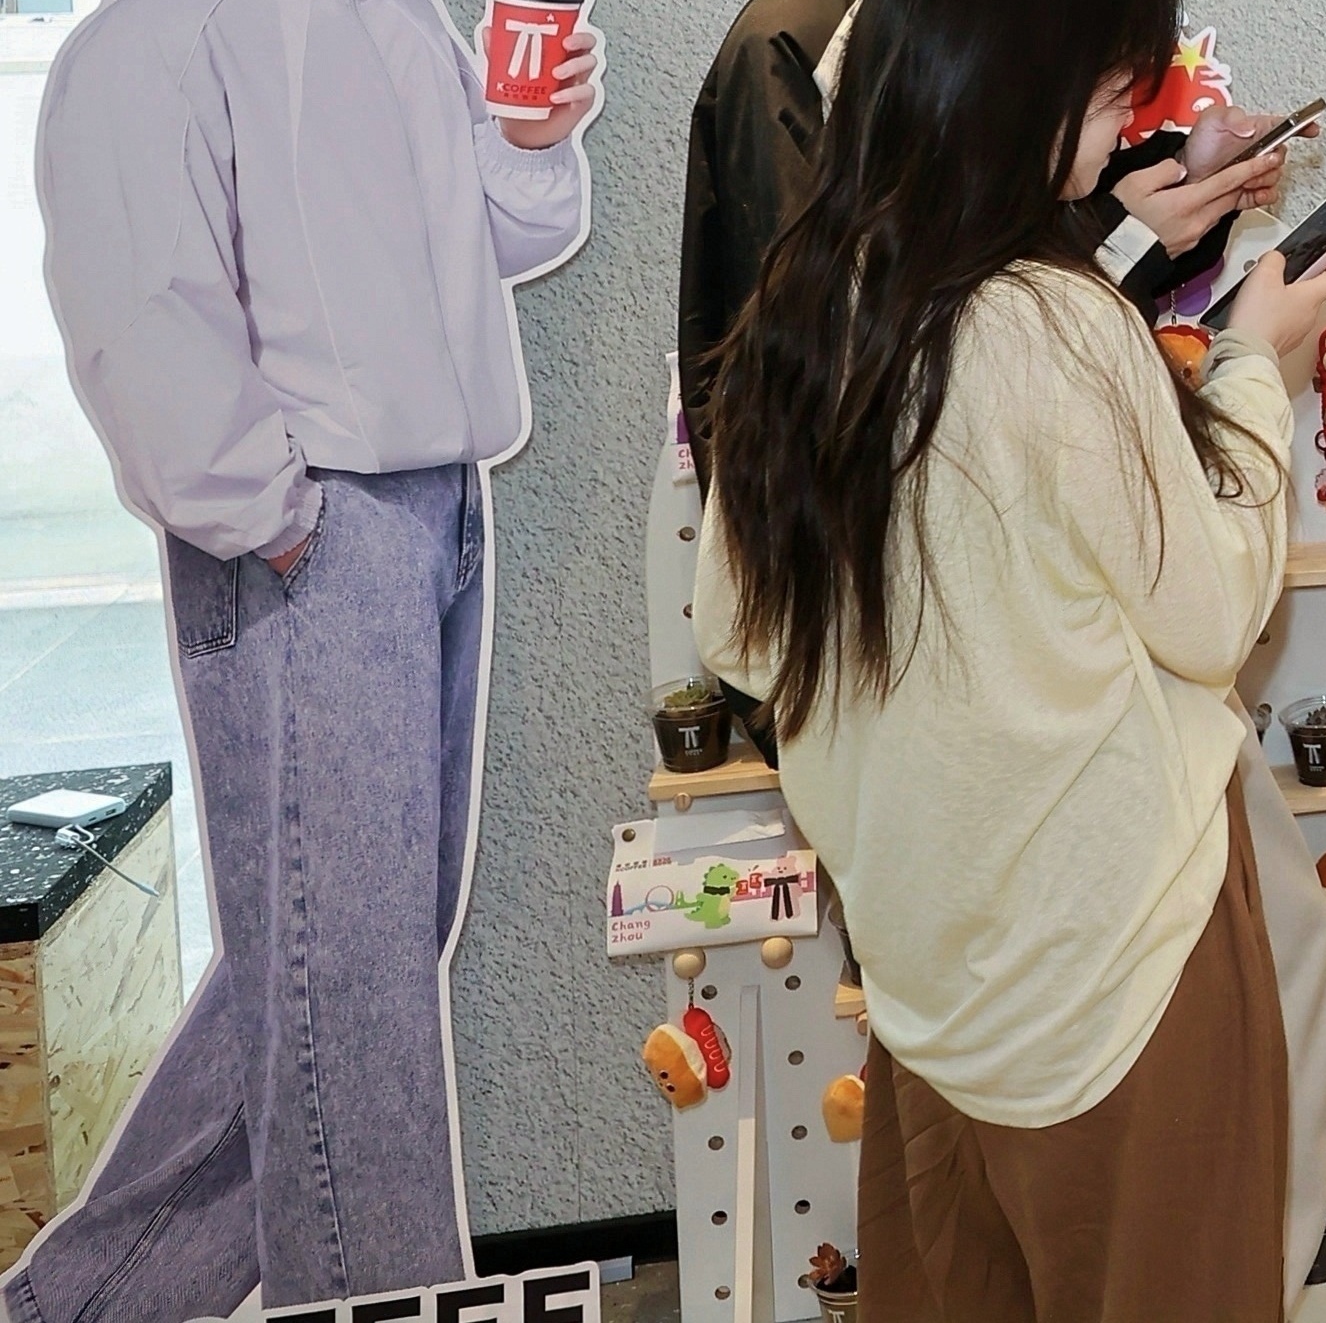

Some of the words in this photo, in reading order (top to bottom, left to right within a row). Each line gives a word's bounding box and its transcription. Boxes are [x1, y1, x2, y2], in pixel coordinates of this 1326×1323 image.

[496, 82, 548, 95] KCOFFEE
[611, 919, 651, 932] Chang
[611, 931, 643, 943] zhou
